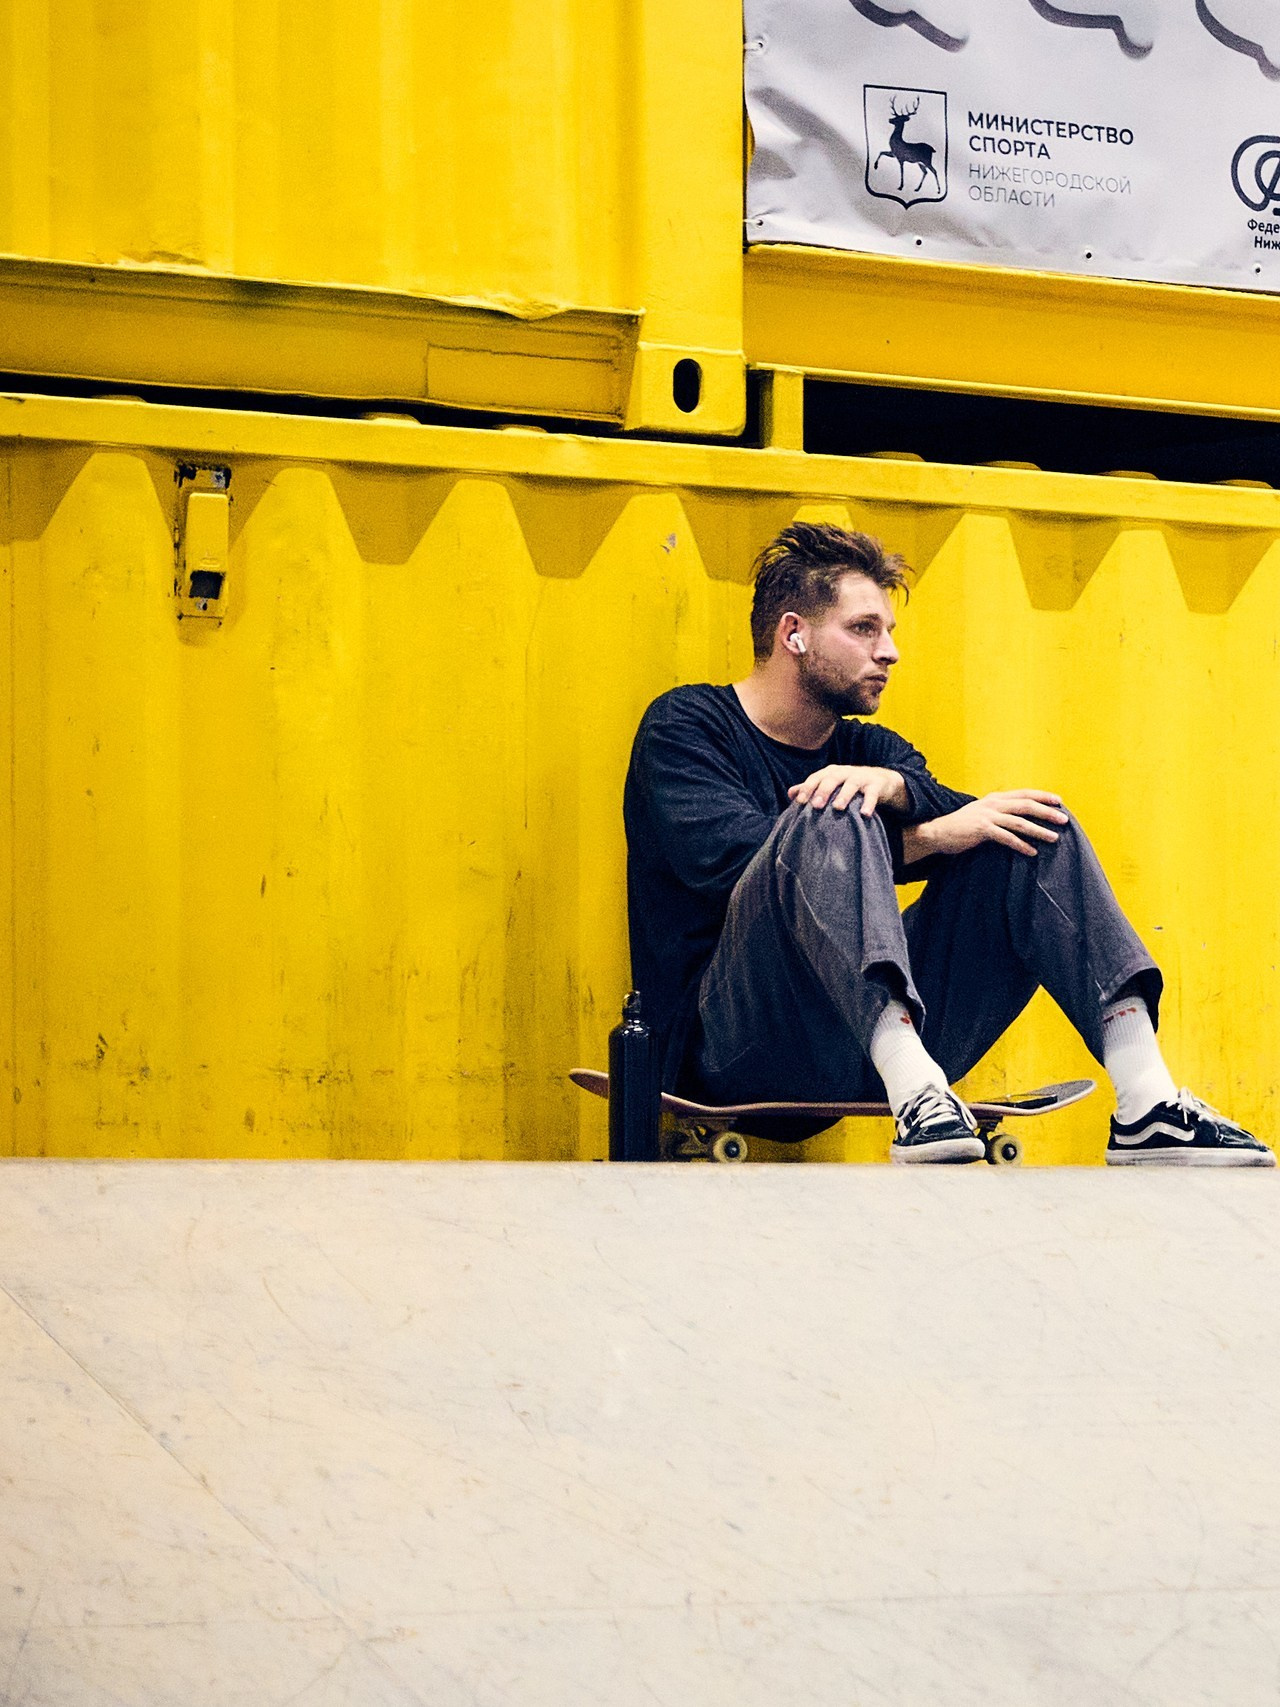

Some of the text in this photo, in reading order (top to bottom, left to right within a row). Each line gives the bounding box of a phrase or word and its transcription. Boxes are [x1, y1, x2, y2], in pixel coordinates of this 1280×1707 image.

[967, 110, 1135, 146] МИНИСТЕРСТВО
[968, 135, 1051, 160] СПОРТА
[968, 162, 1132, 194] НИЖЕГОРОДСКОЙ
[968, 185, 1056, 208] ОБЛАСТИ
